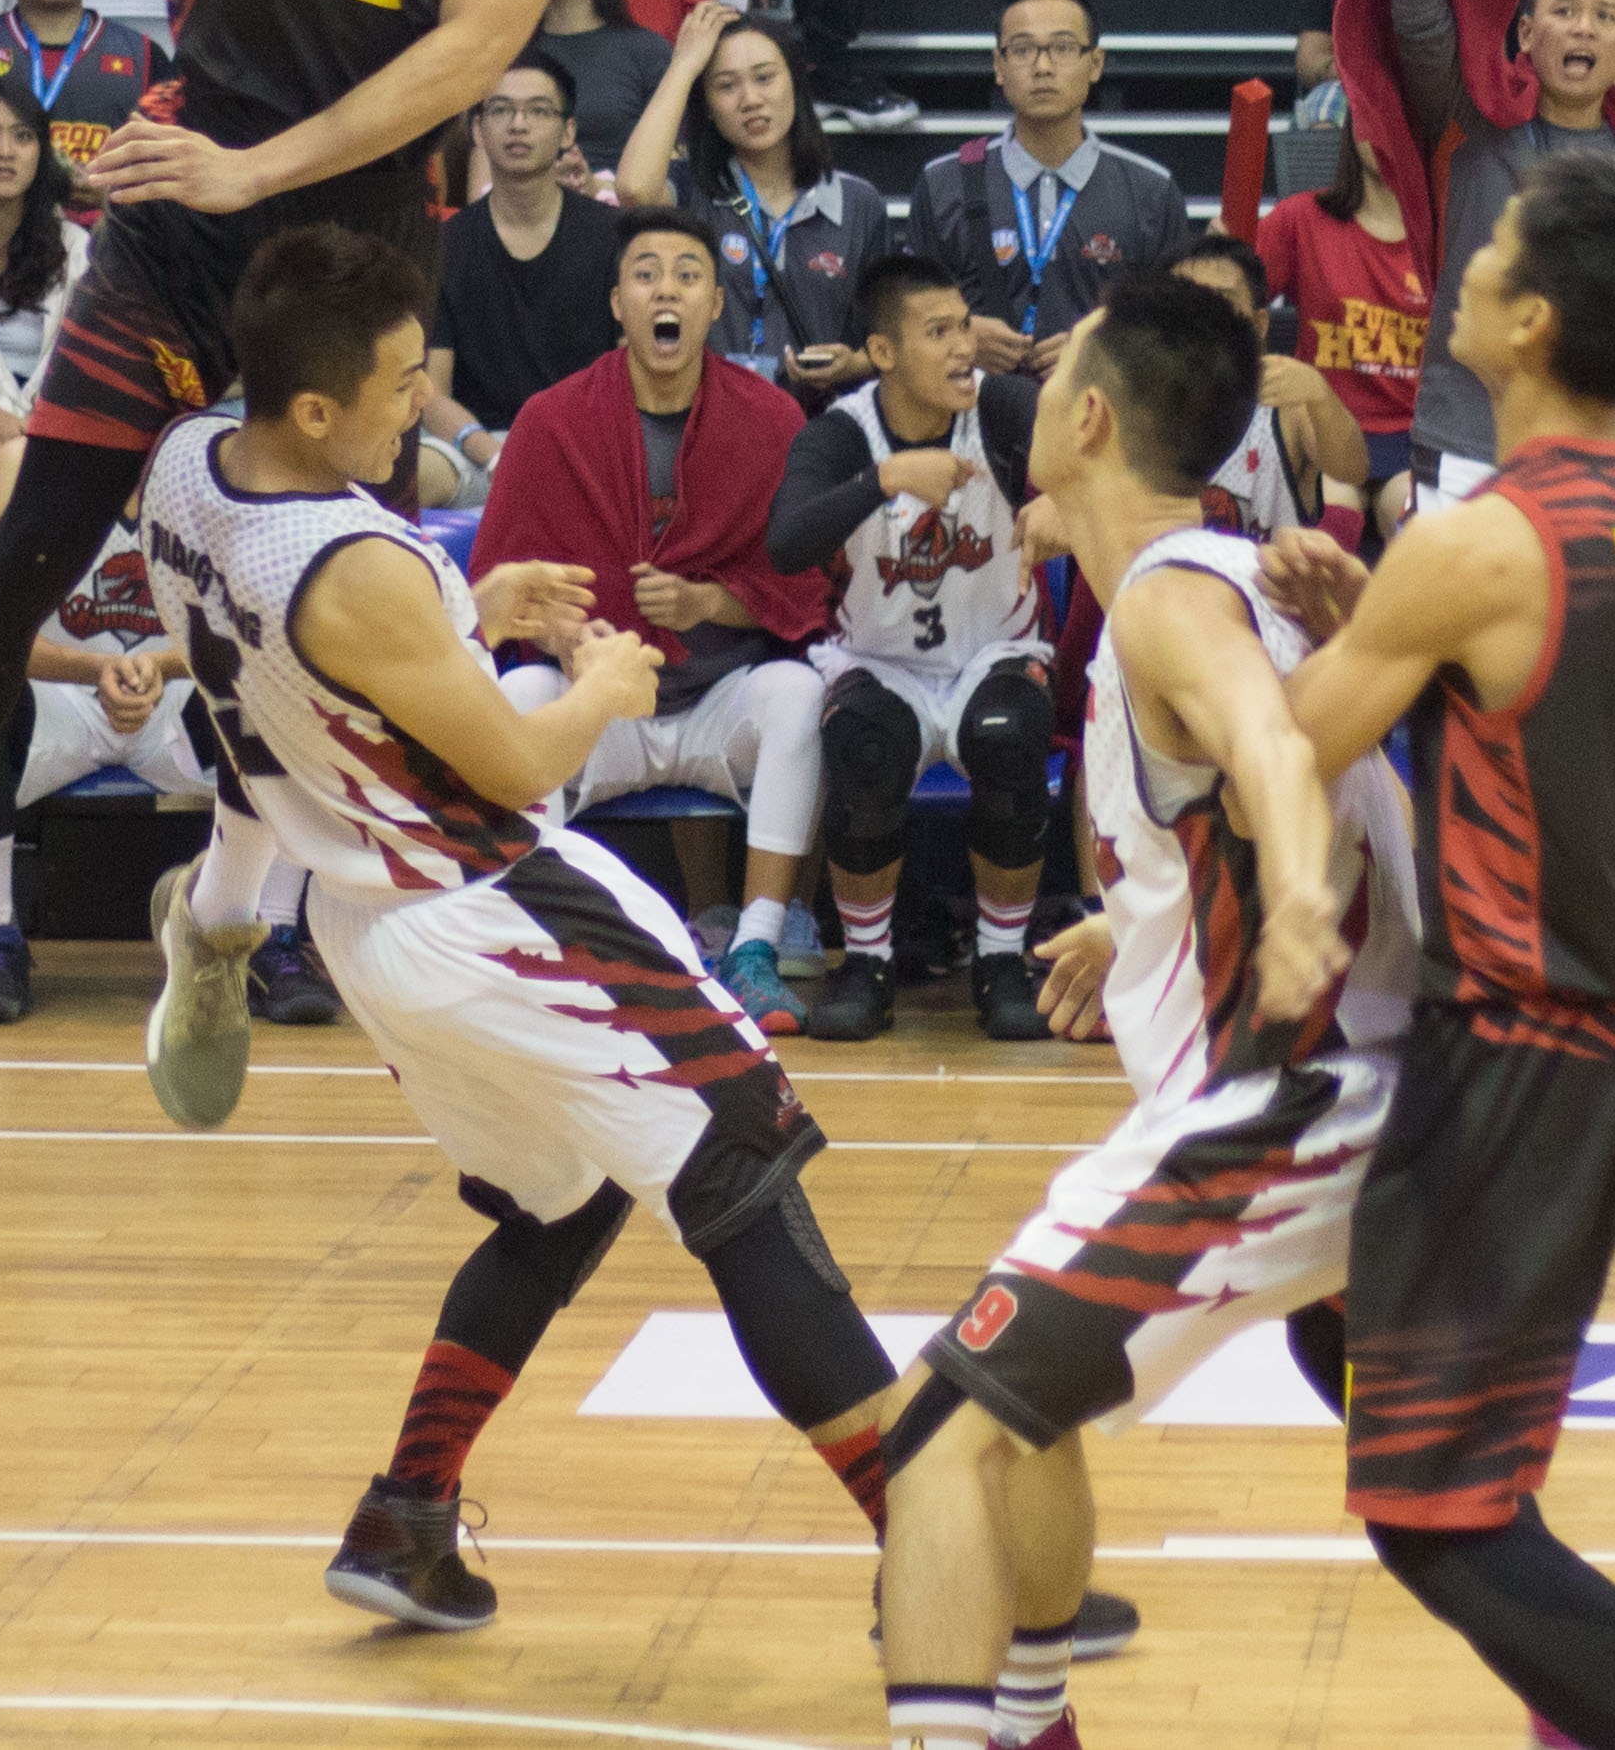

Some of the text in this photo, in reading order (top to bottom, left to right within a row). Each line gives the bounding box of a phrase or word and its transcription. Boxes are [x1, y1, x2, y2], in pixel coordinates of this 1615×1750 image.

[1310, 318, 1426, 369] HEAT
[913, 603, 947, 652] 3
[957, 1284, 1018, 1353] 9
